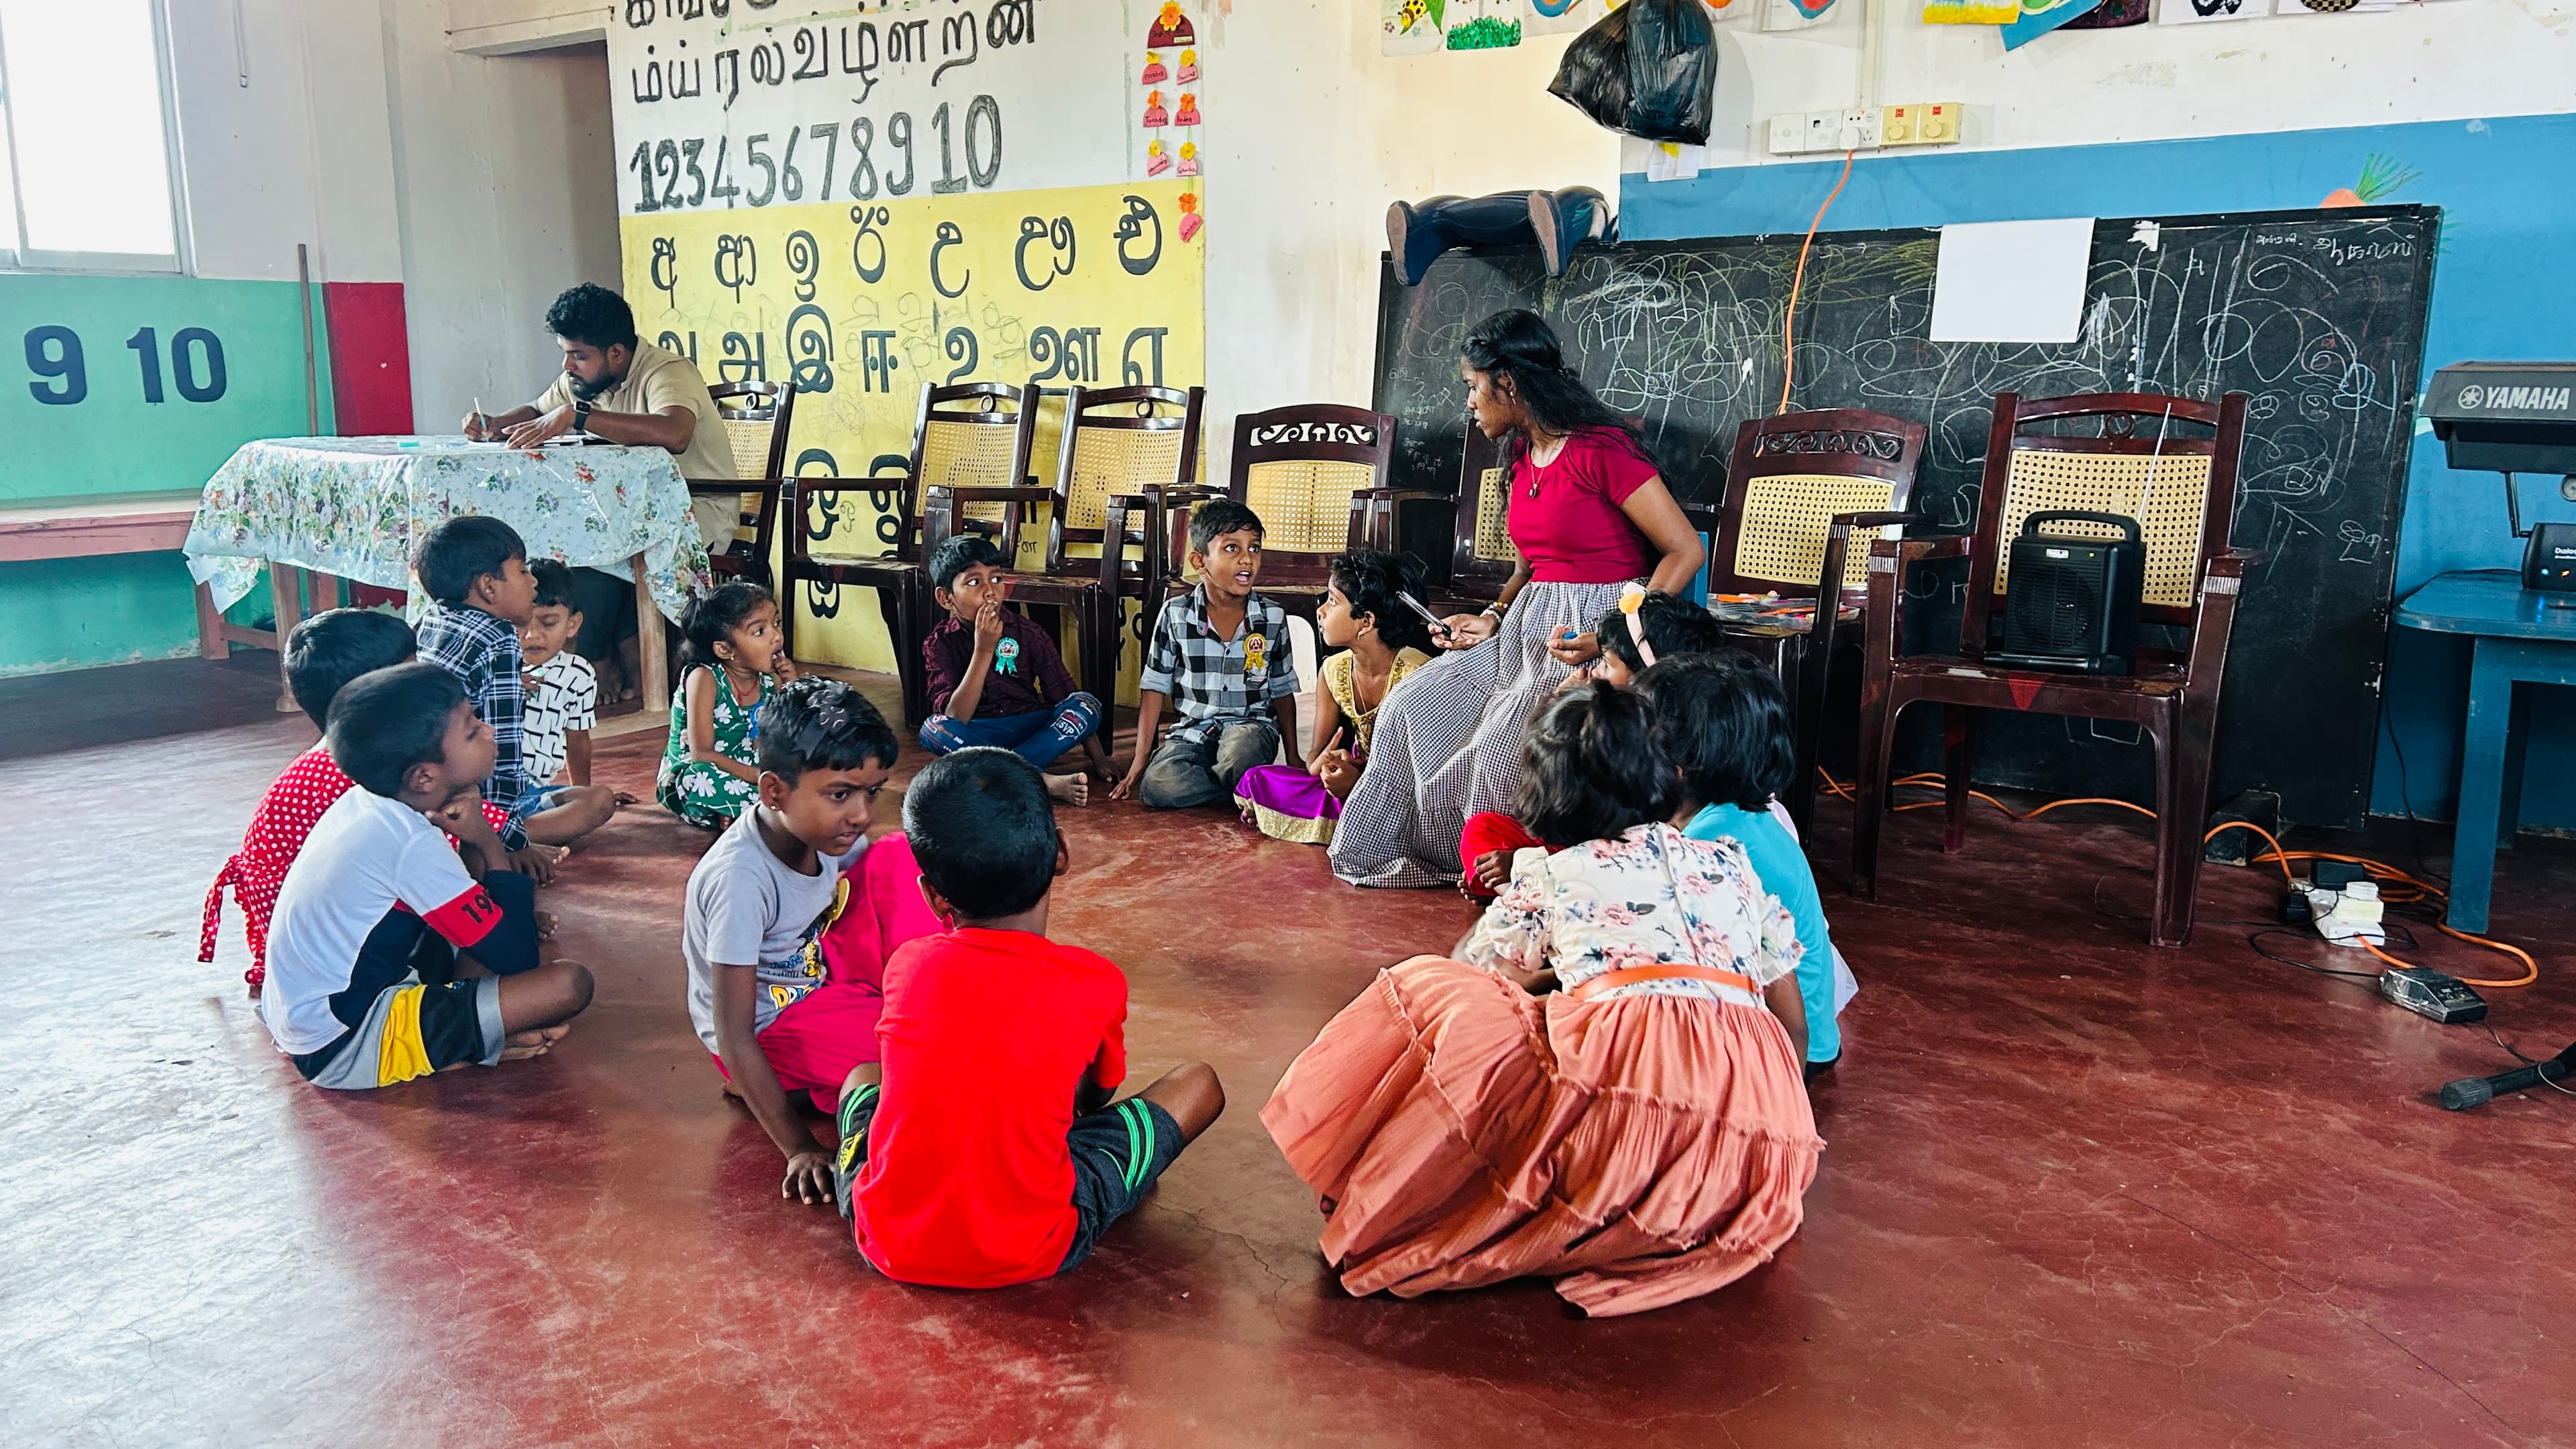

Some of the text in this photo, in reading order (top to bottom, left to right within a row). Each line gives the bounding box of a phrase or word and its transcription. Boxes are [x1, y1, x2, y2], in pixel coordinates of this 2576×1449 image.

[23, 325, 227, 405] 9 10
[2484, 386, 2571, 410] YAMAHA
[462, 894, 494, 924] 19
